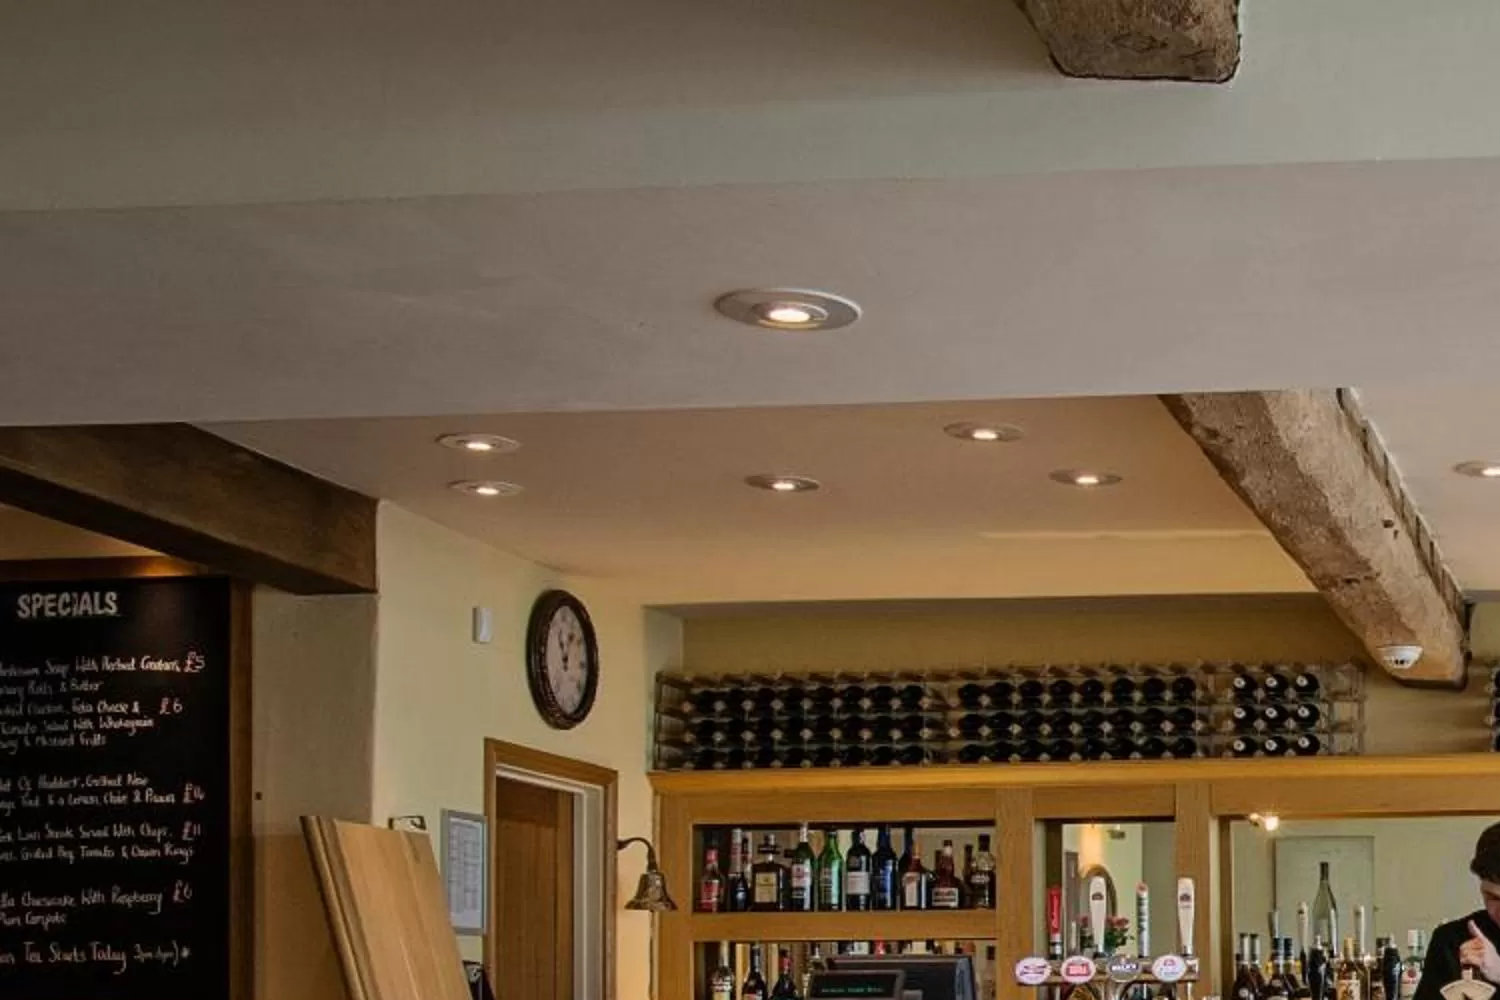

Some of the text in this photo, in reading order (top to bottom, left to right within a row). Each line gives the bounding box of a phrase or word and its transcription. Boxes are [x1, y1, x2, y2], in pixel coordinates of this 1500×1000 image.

[17, 592, 119, 618] SPECIALS
[75, 655, 99, 673] With
[184, 651, 206, 673] £5
[97, 699, 129, 714] Cheese
[81, 885, 105, 905] With
[111, 884, 163, 915] Raspberry
[88, 940, 127, 976] Today
